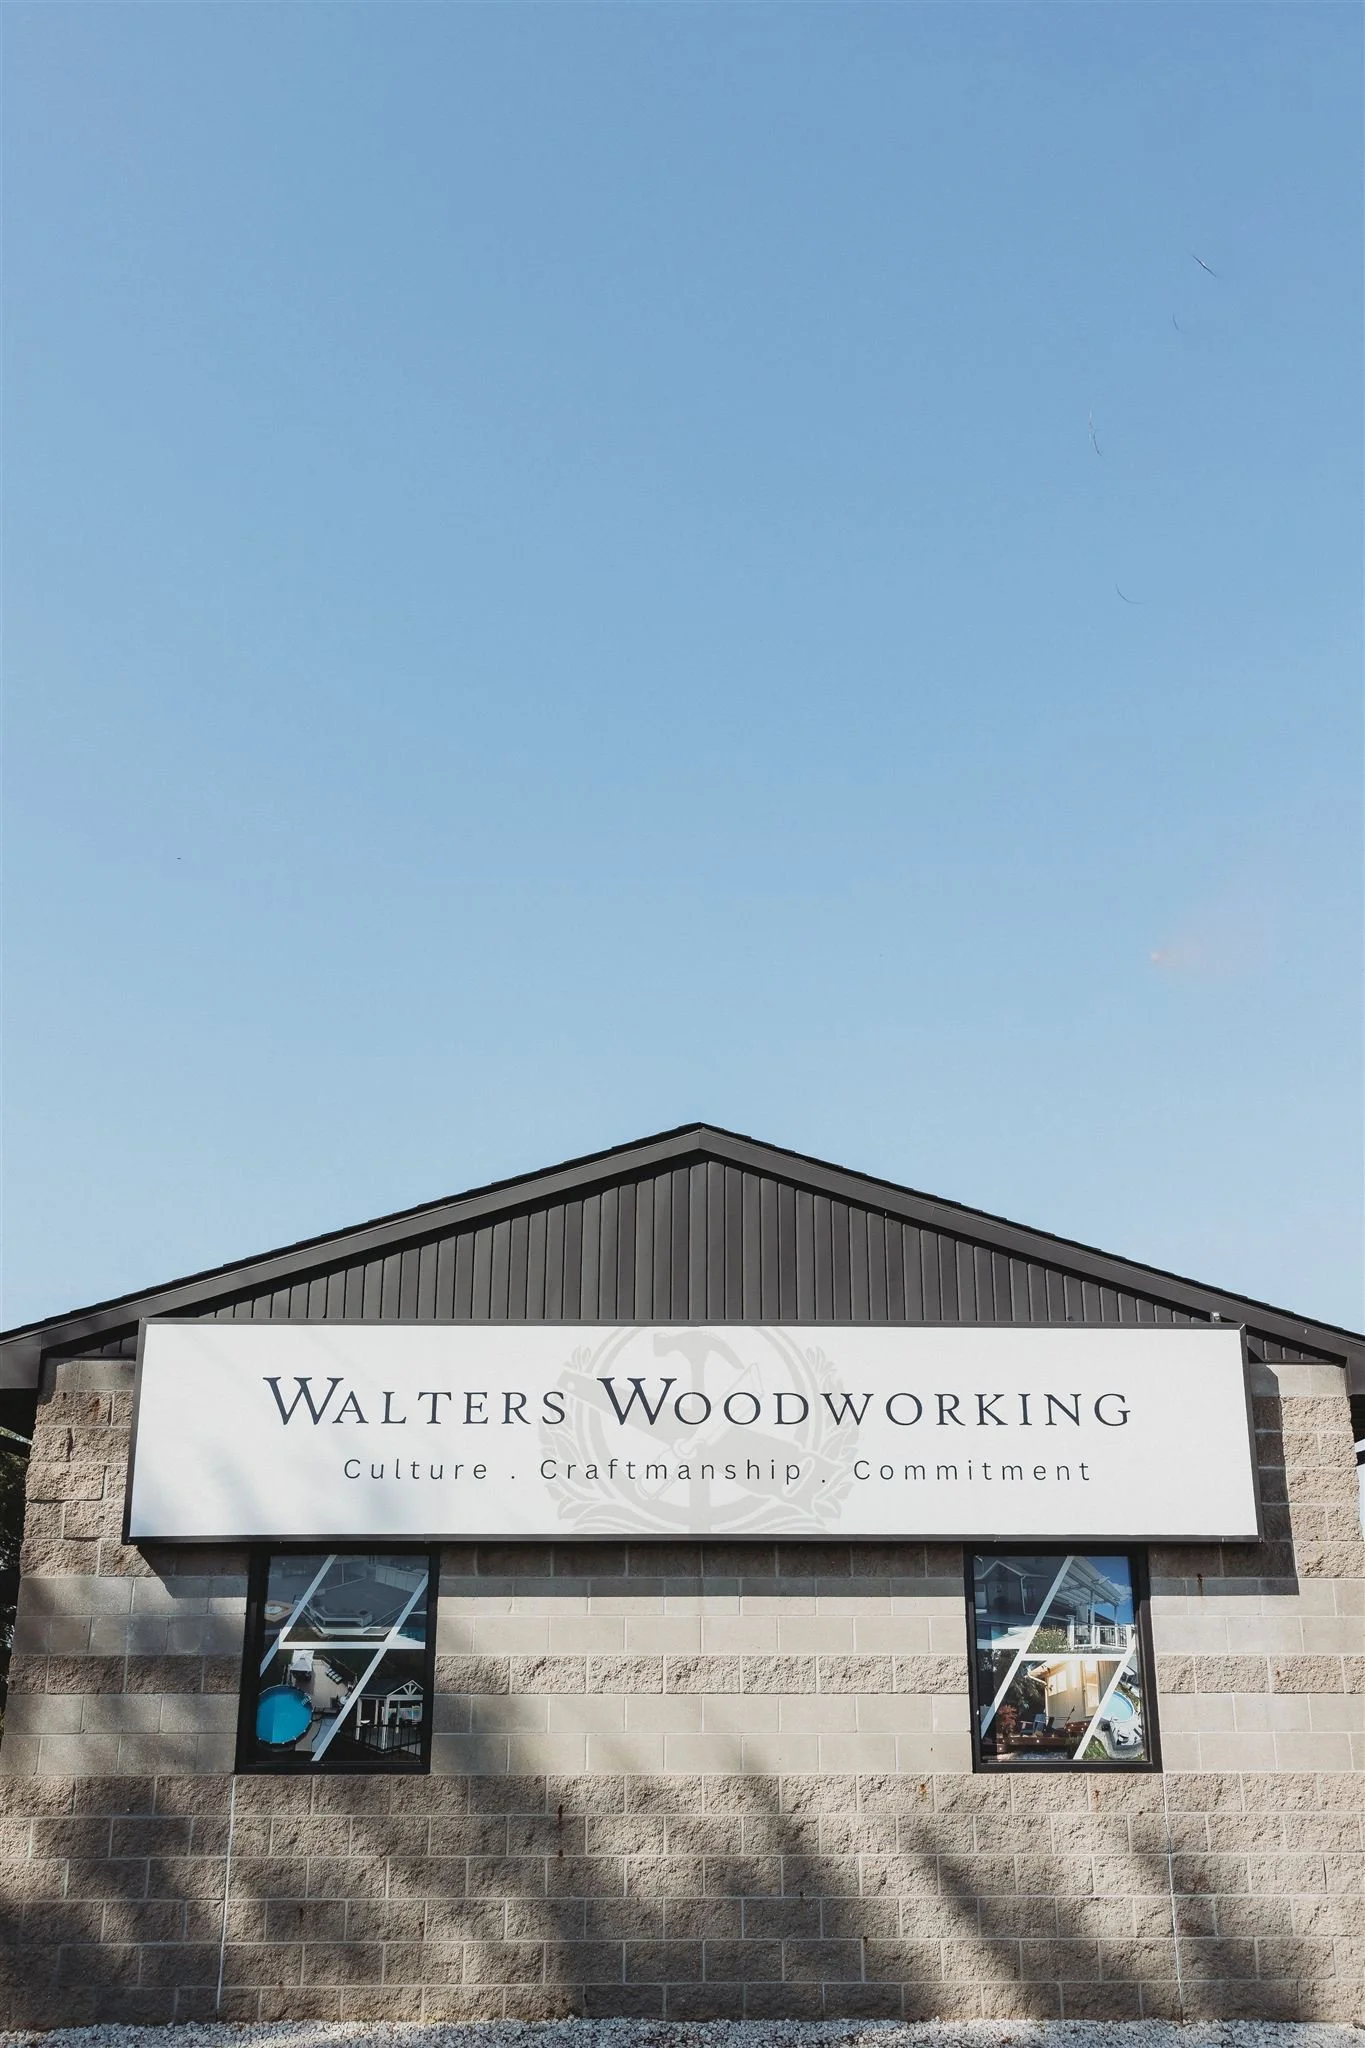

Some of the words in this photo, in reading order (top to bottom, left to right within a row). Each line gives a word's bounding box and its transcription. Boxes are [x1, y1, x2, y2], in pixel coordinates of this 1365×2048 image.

[262, 1376, 567, 1426] WALTERS
[596, 1376, 1132, 1427] WOODWORKING
[343, 1458, 488, 1480] Culture
[540, 1458, 800, 1486] Craftmanship
[853, 1459, 1090, 1482] Commitment
